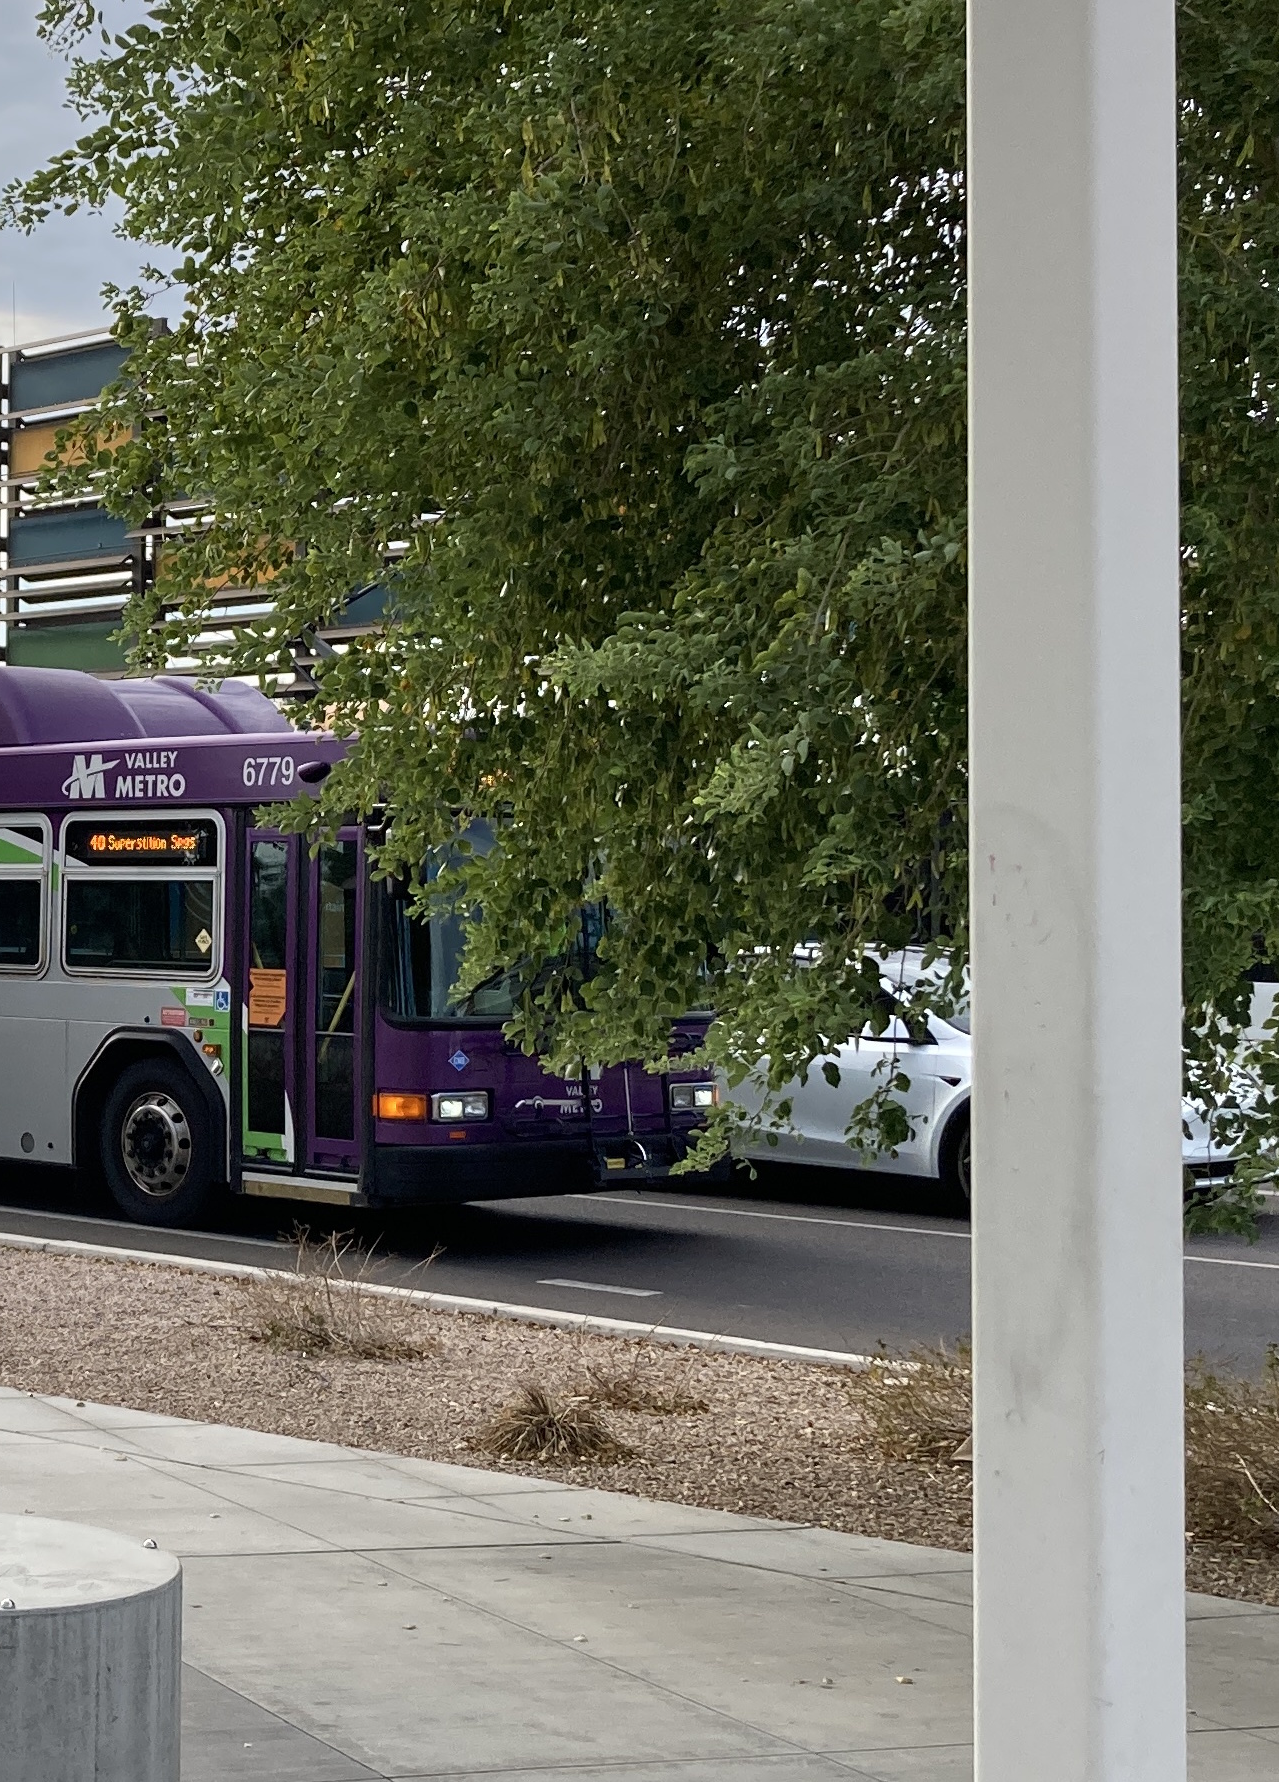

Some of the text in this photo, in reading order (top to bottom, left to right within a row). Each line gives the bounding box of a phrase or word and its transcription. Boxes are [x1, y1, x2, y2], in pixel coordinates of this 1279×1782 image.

[124, 751, 178, 769] VALLEY
[243, 756, 295, 786] 6779
[115, 773, 186, 798] METRO
[90, 834, 106, 851] 40
[107, 834, 167, 851] Superstition
